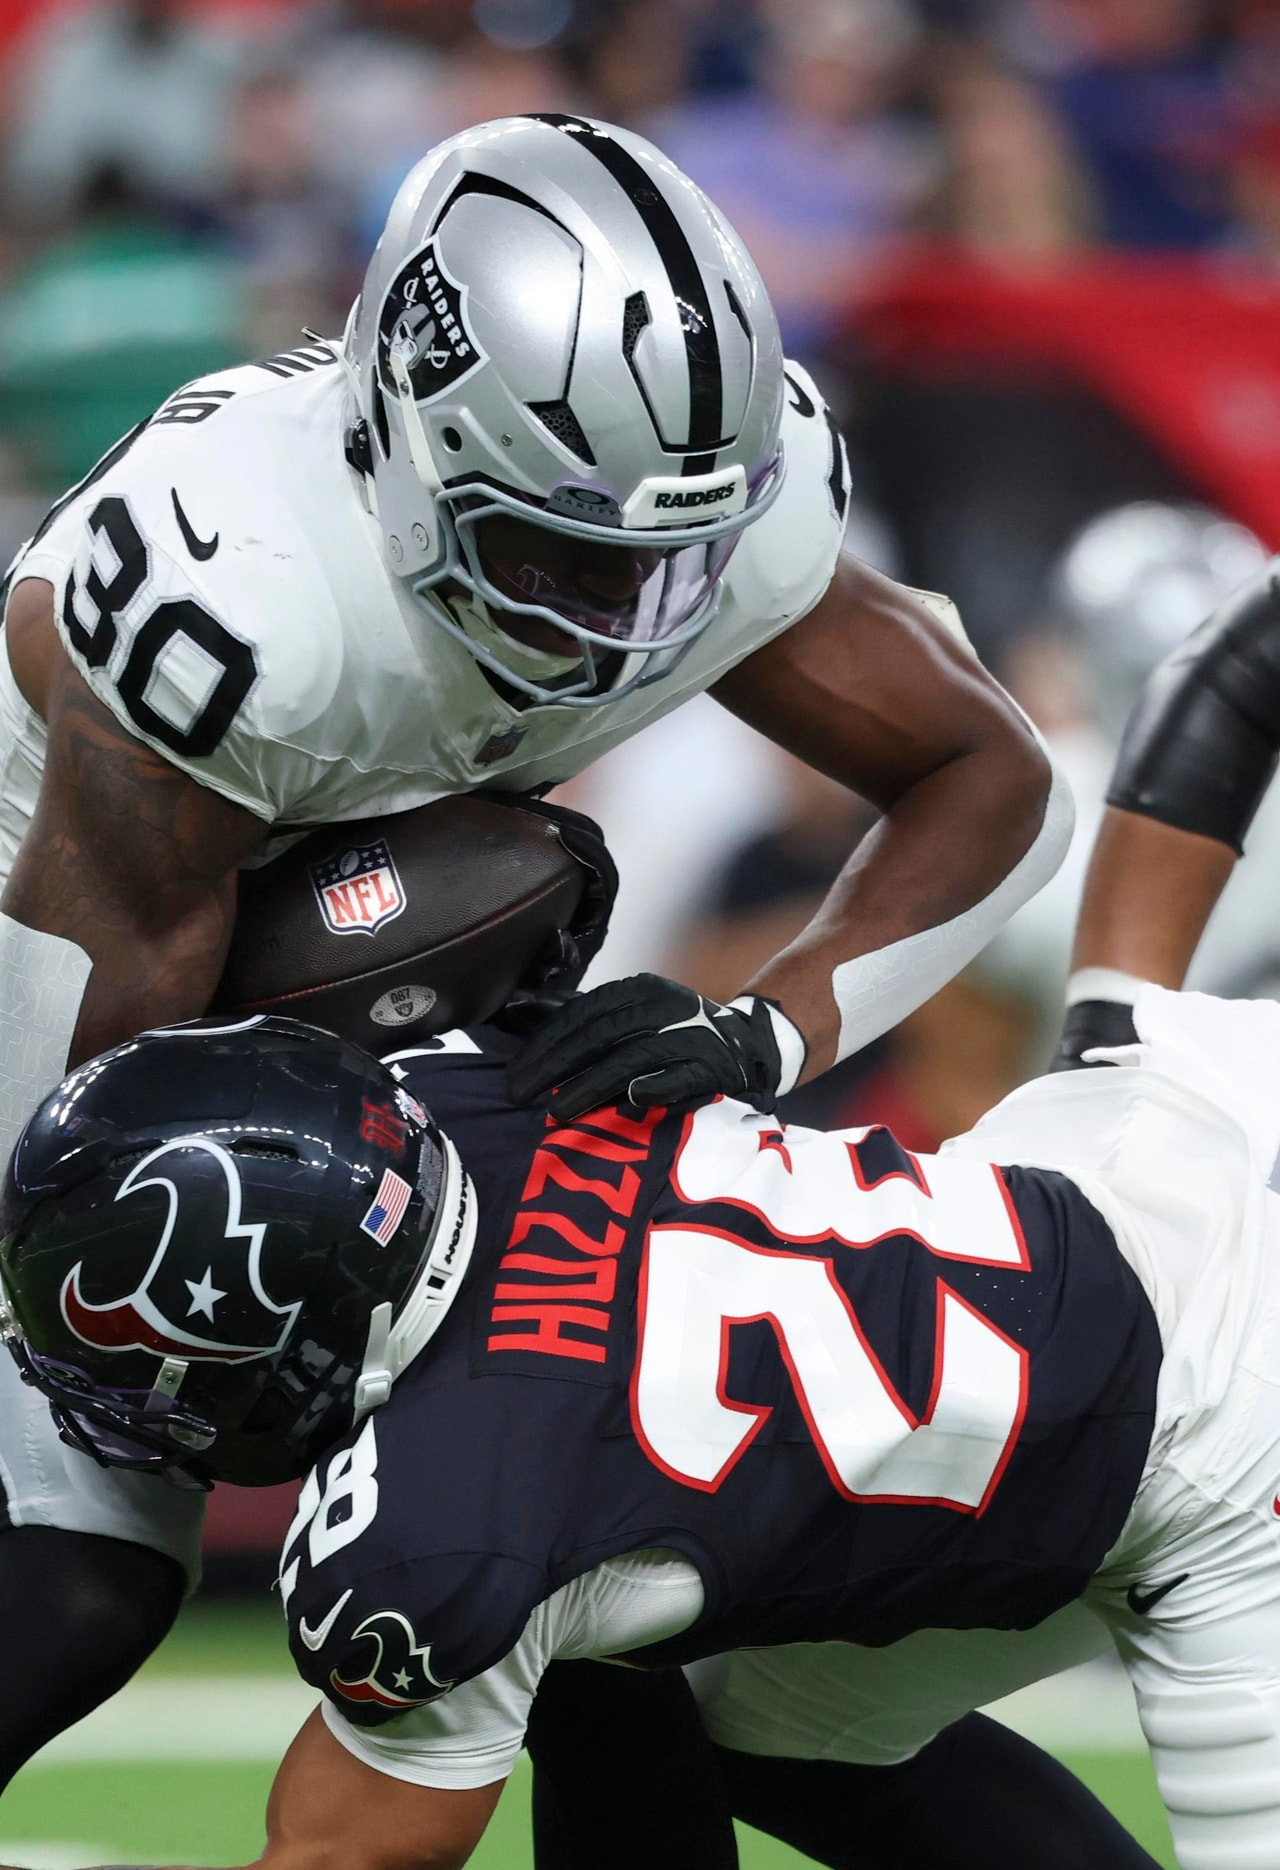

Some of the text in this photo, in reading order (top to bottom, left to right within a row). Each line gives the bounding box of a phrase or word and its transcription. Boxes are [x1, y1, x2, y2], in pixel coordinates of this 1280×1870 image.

[421, 257, 470, 357] RAIDERS
[654, 482, 736, 508] RAIDERS
[62, 496, 260, 758] 30
[325, 873, 396, 924] NFL
[391, 987, 410, 1004] 087
[630, 1096, 1032, 1518] 28
